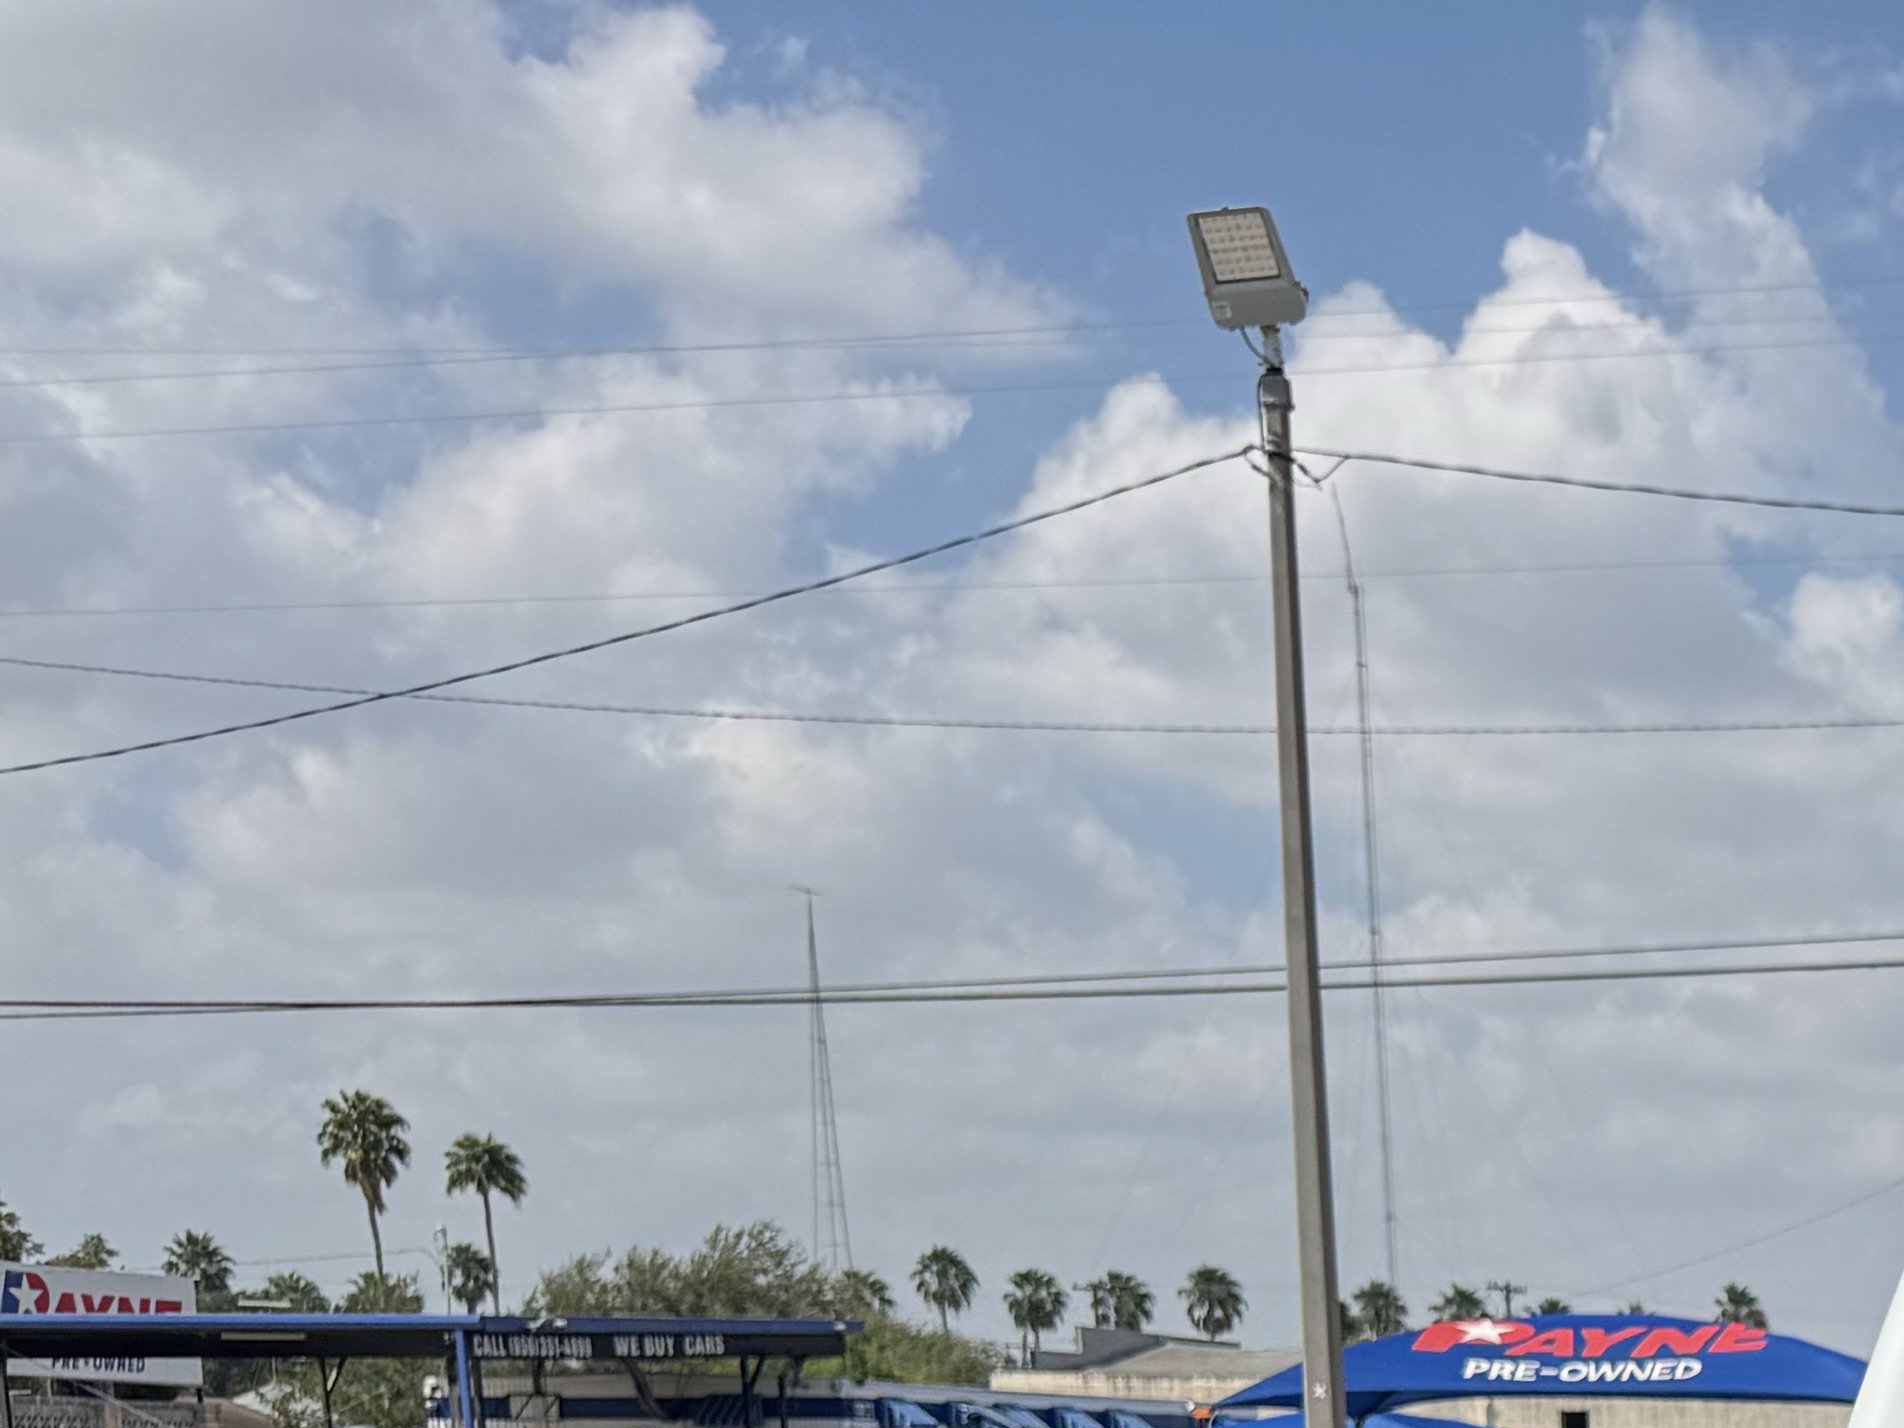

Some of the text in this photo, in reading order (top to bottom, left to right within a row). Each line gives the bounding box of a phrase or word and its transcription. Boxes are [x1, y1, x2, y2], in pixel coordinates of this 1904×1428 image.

[473, 1333, 507, 1357] CALL
[614, 1334, 640, 1357] WE
[643, 1334, 674, 1357] BUY
[684, 1334, 725, 1355] CARS
[1412, 1321, 1767, 1358] PAYNE
[1462, 1357, 1703, 1383] PRE-OWNED
